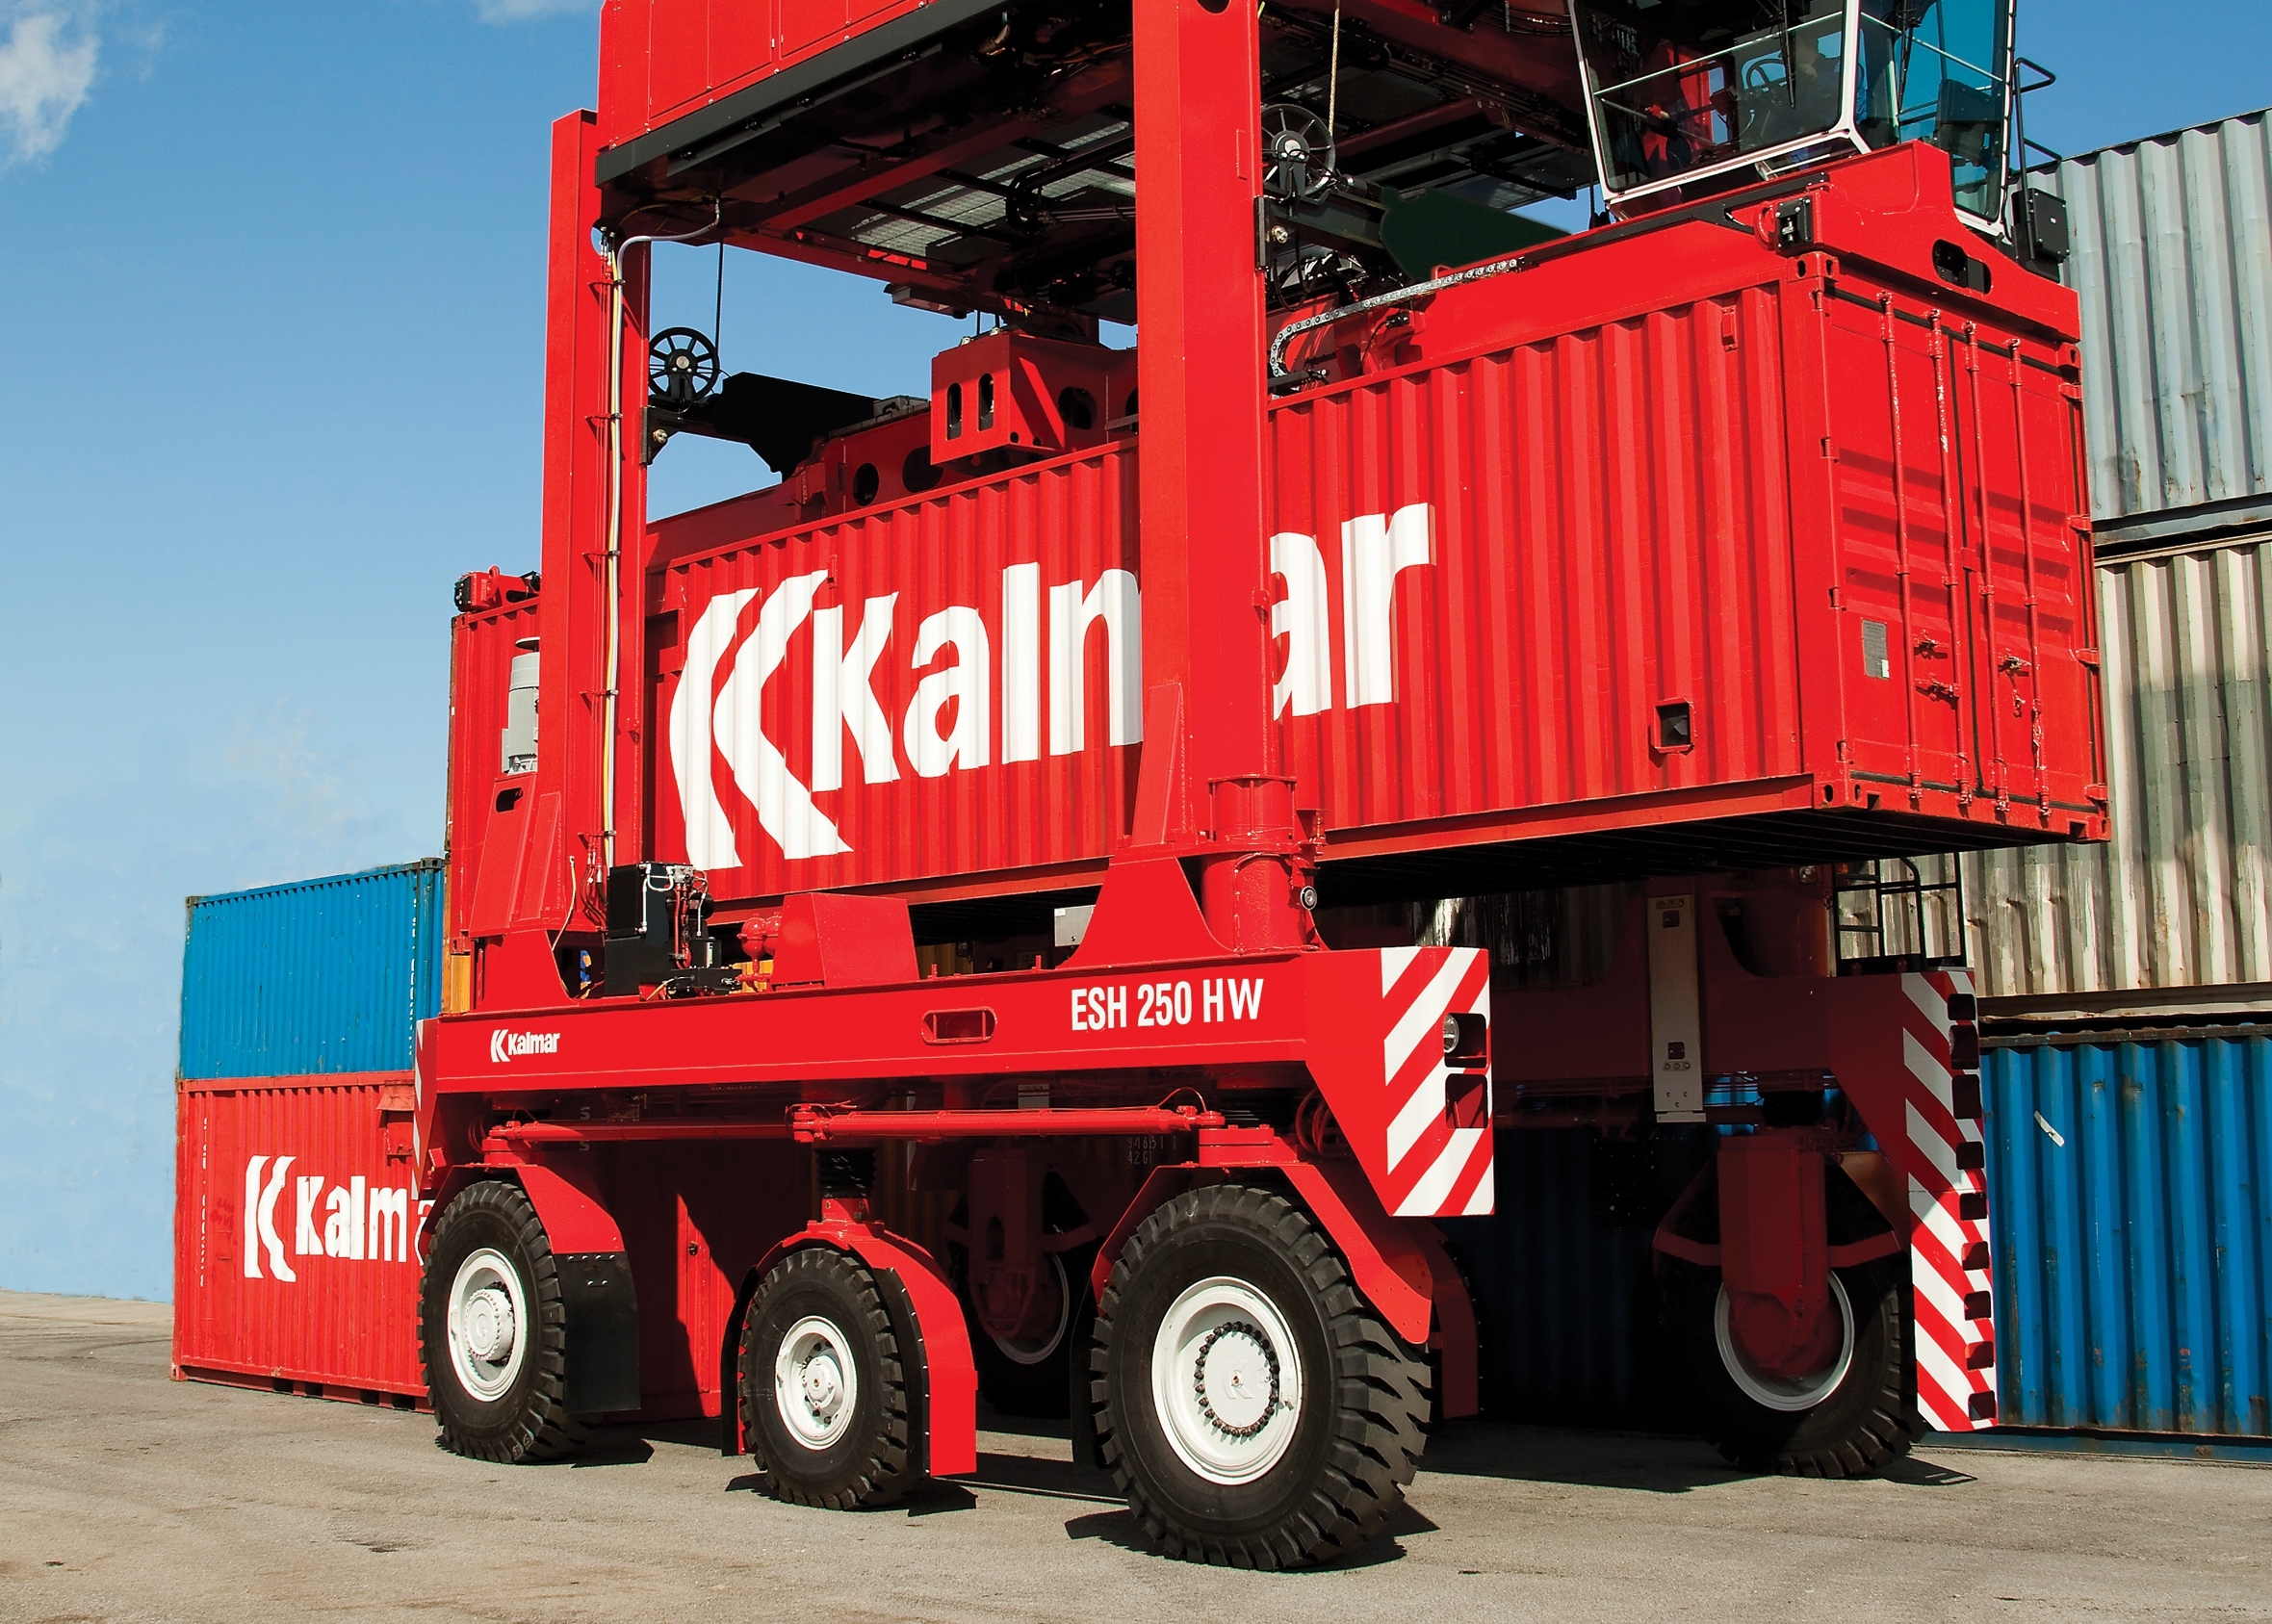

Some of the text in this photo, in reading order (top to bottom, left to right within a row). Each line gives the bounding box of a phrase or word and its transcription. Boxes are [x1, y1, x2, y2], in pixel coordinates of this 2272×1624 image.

[1071, 978, 1264, 1031] ESH 250 HW
[507, 1031, 561, 1056] Kalmar
